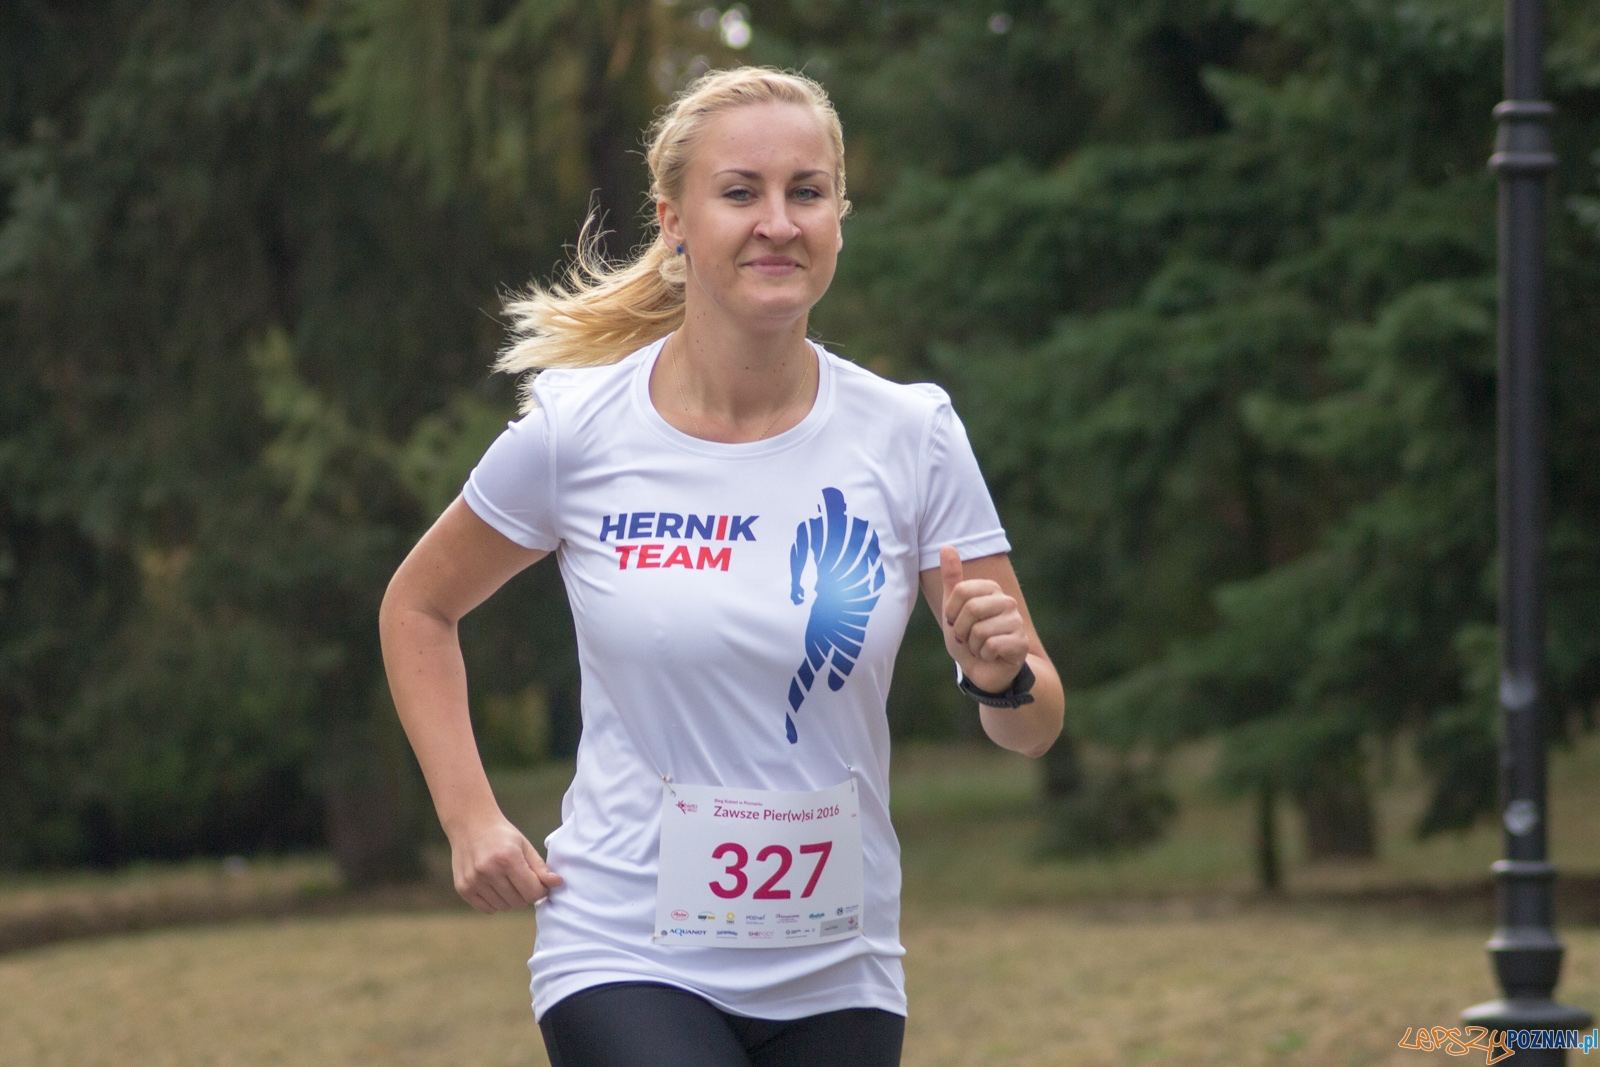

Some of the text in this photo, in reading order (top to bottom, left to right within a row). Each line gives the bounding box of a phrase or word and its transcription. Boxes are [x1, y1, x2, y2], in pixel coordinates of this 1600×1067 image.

[599, 512, 760, 542] HERNIK
[615, 544, 732, 572] TEAM
[713, 805, 760, 820] Zawsze
[763, 809, 814, 823] Pier(w)si
[816, 804, 840, 820] 2016
[708, 840, 833, 900] 327
